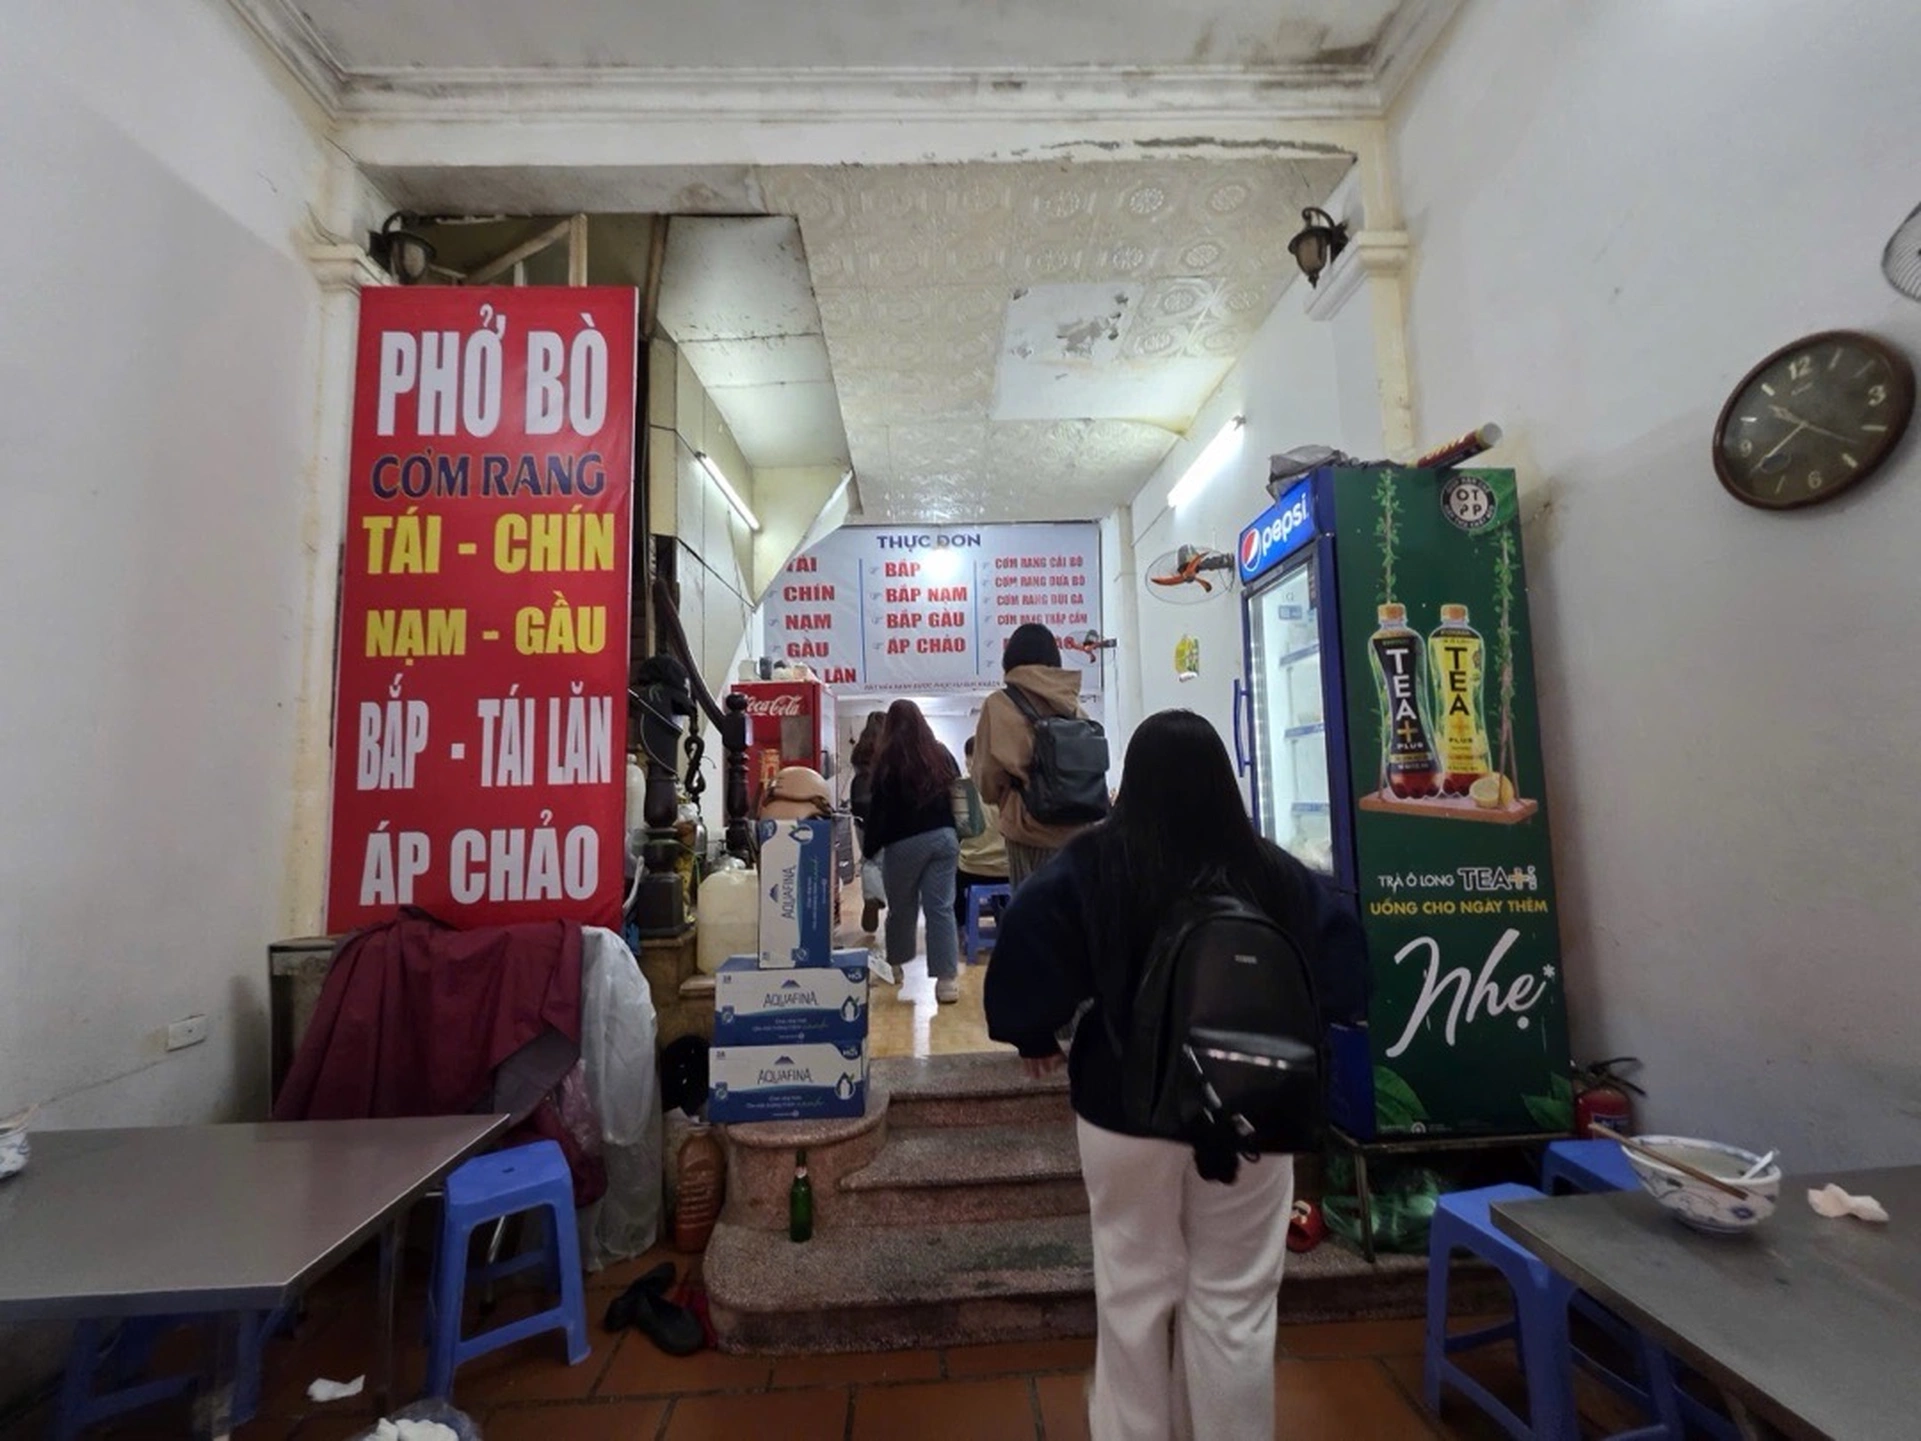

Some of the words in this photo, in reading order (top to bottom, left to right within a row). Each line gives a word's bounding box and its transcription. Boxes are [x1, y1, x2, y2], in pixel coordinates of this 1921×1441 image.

[376, 304, 506, 438] PHỞ
[525, 312, 608, 438] BÒ
[1789, 355, 1811, 381] 12
[1867, 385, 1887, 406] 3
[1740, 439, 1753, 458] 9
[371, 447, 470, 499] CƠM
[480, 452, 606, 498] RANG
[1807, 470, 1822, 489] 6
[1262, 492, 1307, 556] pepsi
[362, 506, 442, 575] TÁI
[494, 504, 615, 574] CHÍN
[876, 534, 931, 552] THỰC
[783, 583, 835, 602] CHÍN
[927, 586, 968, 605] NẠM
[365, 608, 467, 666] NẠM
[515, 590, 607, 655] GẦU
[785, 613, 832, 633] NẠM
[787, 636, 829, 658] GẦU
[356, 673, 430, 790] BẮP
[477, 684, 536, 787] TÁI
[547, 681, 613, 785] LĂN
[359, 820, 431, 906] ÁP
[450, 809, 600, 905] CHẢO
[1406, 872, 1418, 887] Ô
[1420, 874, 1455, 887] LONG
[781, 865, 797, 921] AQUAFINA
[1370, 898, 1418, 915] UỐNG
[1422, 901, 1455, 914] CHO
[1460, 898, 1504, 914] NGÀY
[1507, 898, 1549, 913] THÊM
[763, 991, 819, 1008] AQUAFINA
[757, 1068, 814, 1085] AQUAFINA
